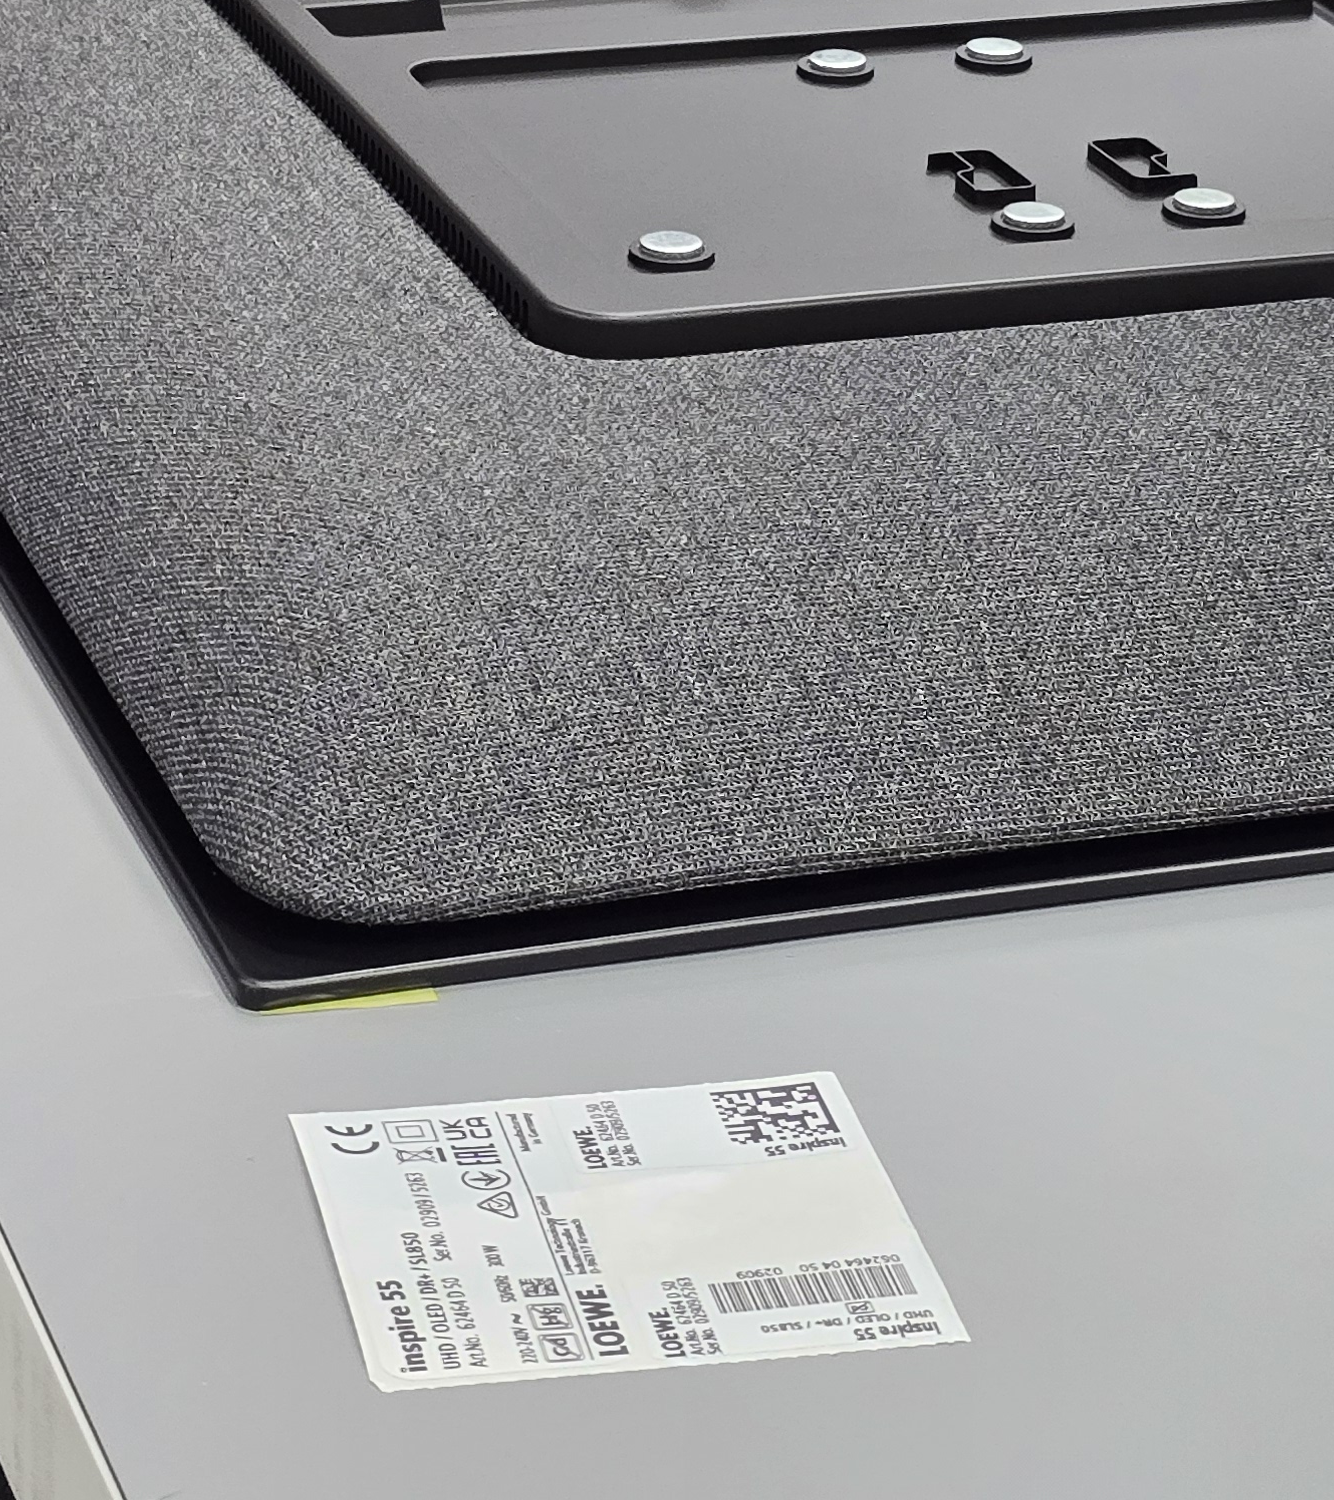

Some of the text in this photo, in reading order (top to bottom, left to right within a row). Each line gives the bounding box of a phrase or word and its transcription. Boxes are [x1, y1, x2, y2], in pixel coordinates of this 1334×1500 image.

[439, 1119, 467, 1140] UK
[765, 1145, 786, 1156] 55
[405, 1173, 429, 1192] 5263
[415, 1200, 441, 1227] 02909
[401, 1232, 427, 1265] SL850
[799, 1263, 819, 1272] 50
[417, 1274, 438, 1294] DR+
[441, 1278, 462, 1289] 50
[425, 1304, 450, 1333] OLED
[449, 1300, 475, 1330] 62464
[855, 1313, 891, 1323] OLED
[376, 1280, 428, 1373] inspire 55
[854, 1327, 877, 1341] 55
[438, 1343, 461, 1369] UHD
